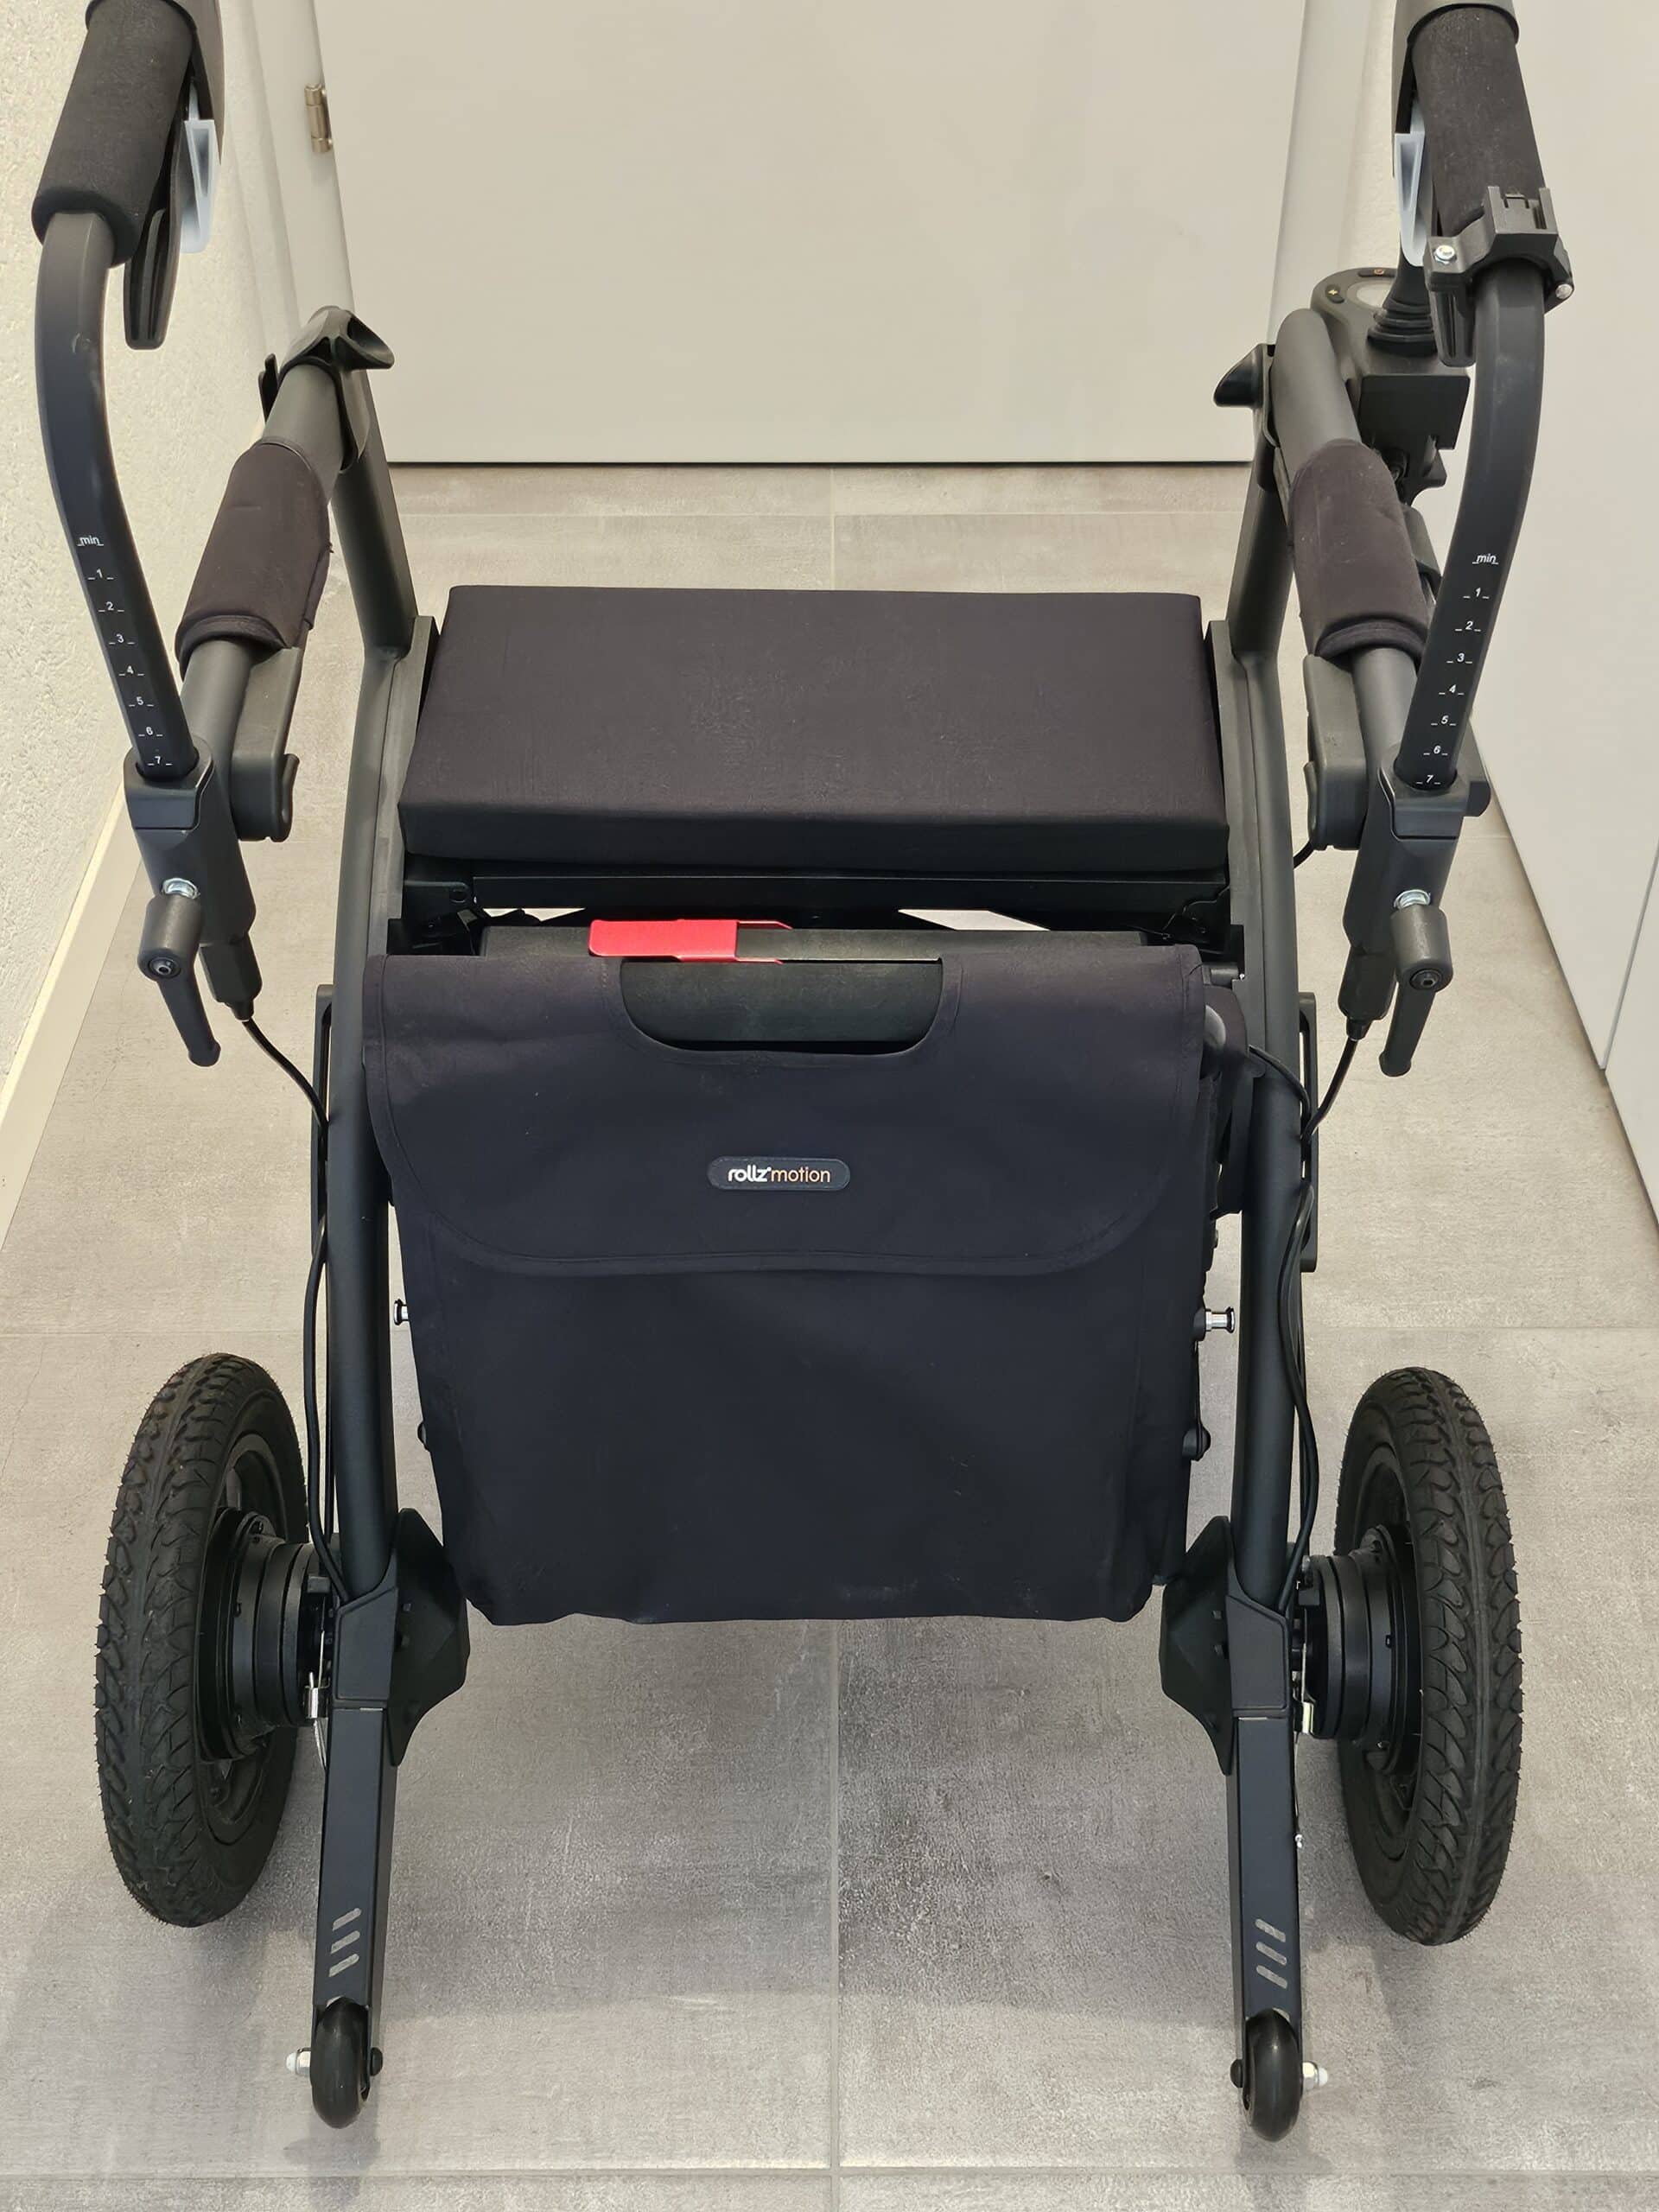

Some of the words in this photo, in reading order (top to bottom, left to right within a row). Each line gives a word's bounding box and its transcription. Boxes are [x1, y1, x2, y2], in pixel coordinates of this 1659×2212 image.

[79, 535, 100, 546] min
[1476, 553, 1497, 563] min
[96, 569, 104, 578] 1
[1474, 587, 1482, 597] 1
[105, 601, 114, 611] 2
[1465, 620, 1473, 630] 2
[116, 633, 124, 643] 3
[1456, 652, 1465, 662] 3
[126, 665, 134, 675] 4
[1448, 683, 1457, 693] 4
[136, 696, 144, 705] 5
[1440, 715, 1449, 724] 5
[145, 726, 154, 735] 6
[1433, 745, 1441, 754] 6
[155, 755, 162, 765] 7
[1426, 774, 1433, 784] 7
